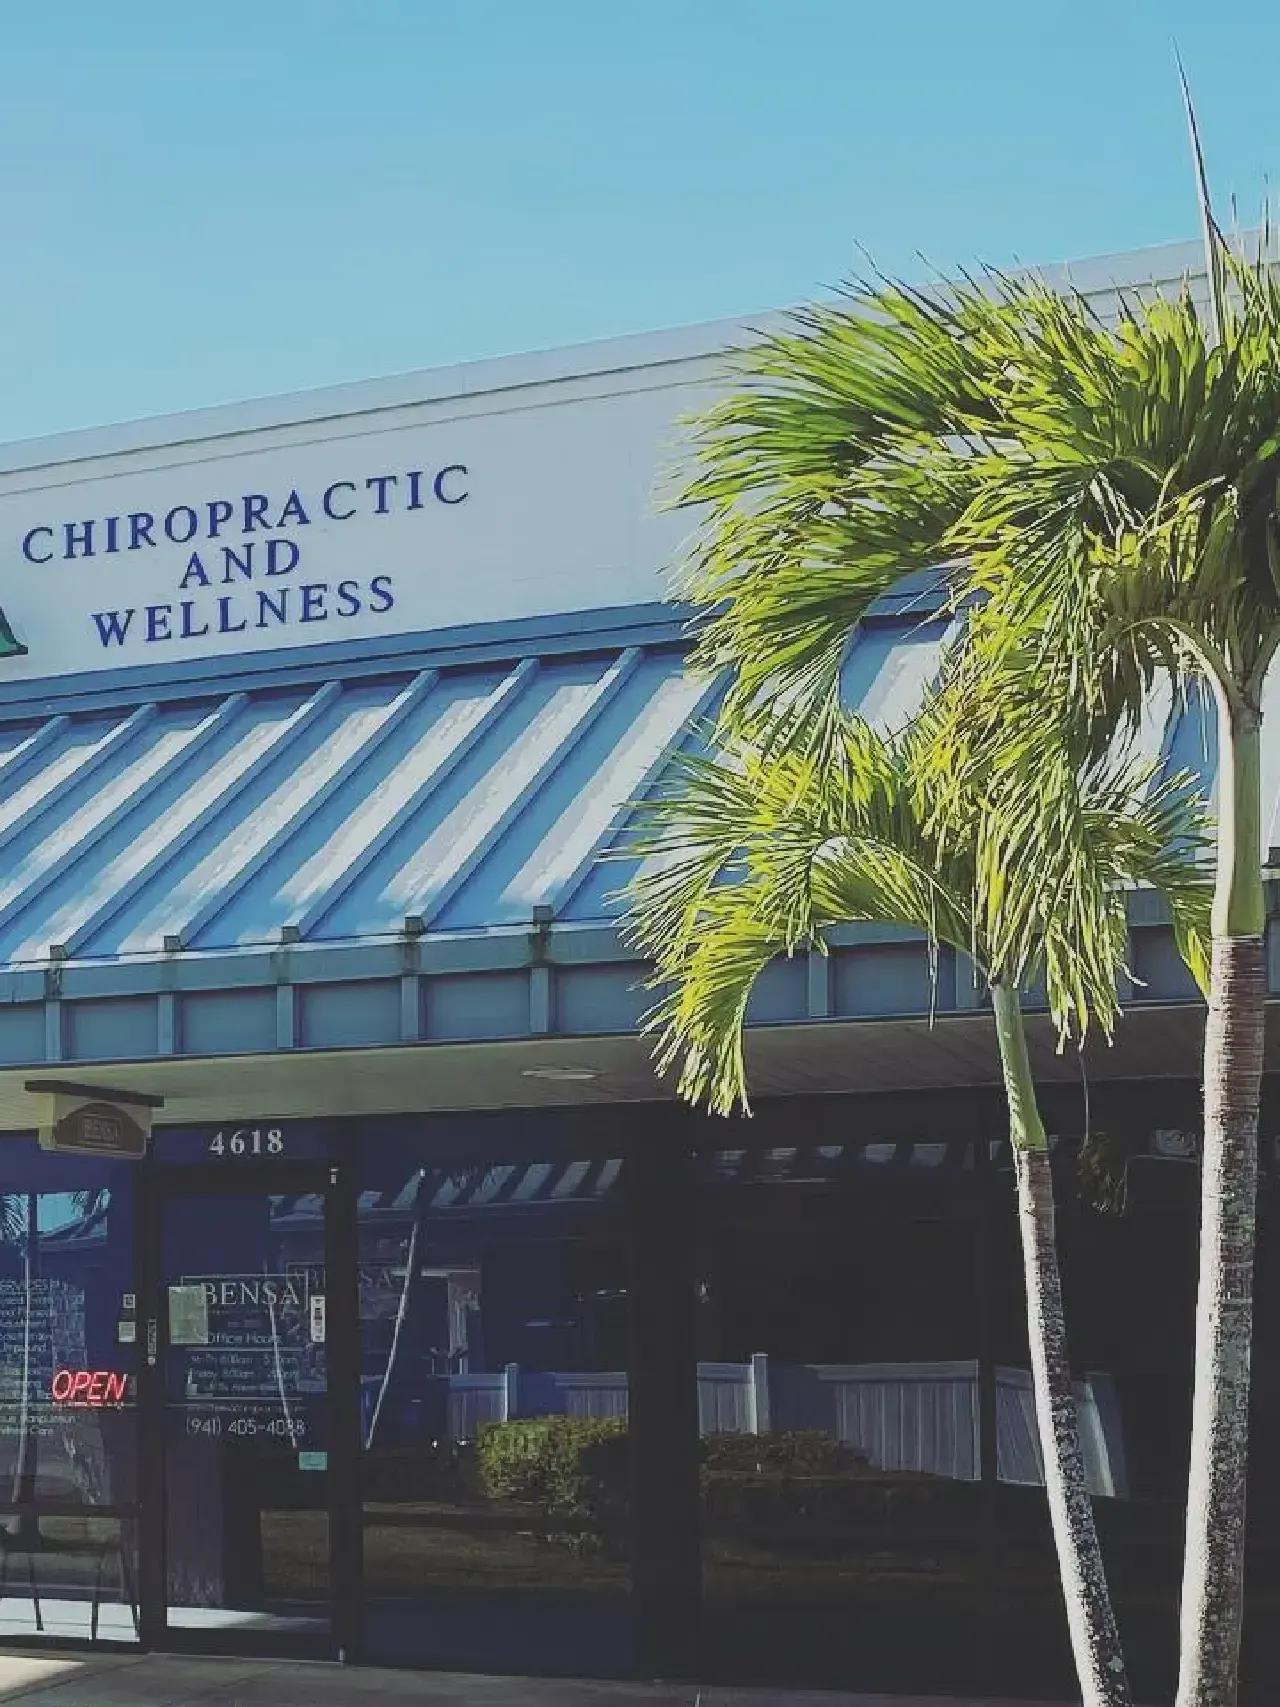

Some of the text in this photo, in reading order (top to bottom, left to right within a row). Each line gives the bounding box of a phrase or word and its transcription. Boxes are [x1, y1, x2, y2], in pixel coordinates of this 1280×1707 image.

[22, 464, 469, 564] CHIROPRACTIC
[179, 539, 301, 589] AND
[91, 576, 396, 649] WELLNESS
[209, 1129, 284, 1156] 4618
[200, 1282, 300, 1305] BENSA
[52, 1370, 128, 1400] OPEN
[186, 1416, 222, 1437] (941)
